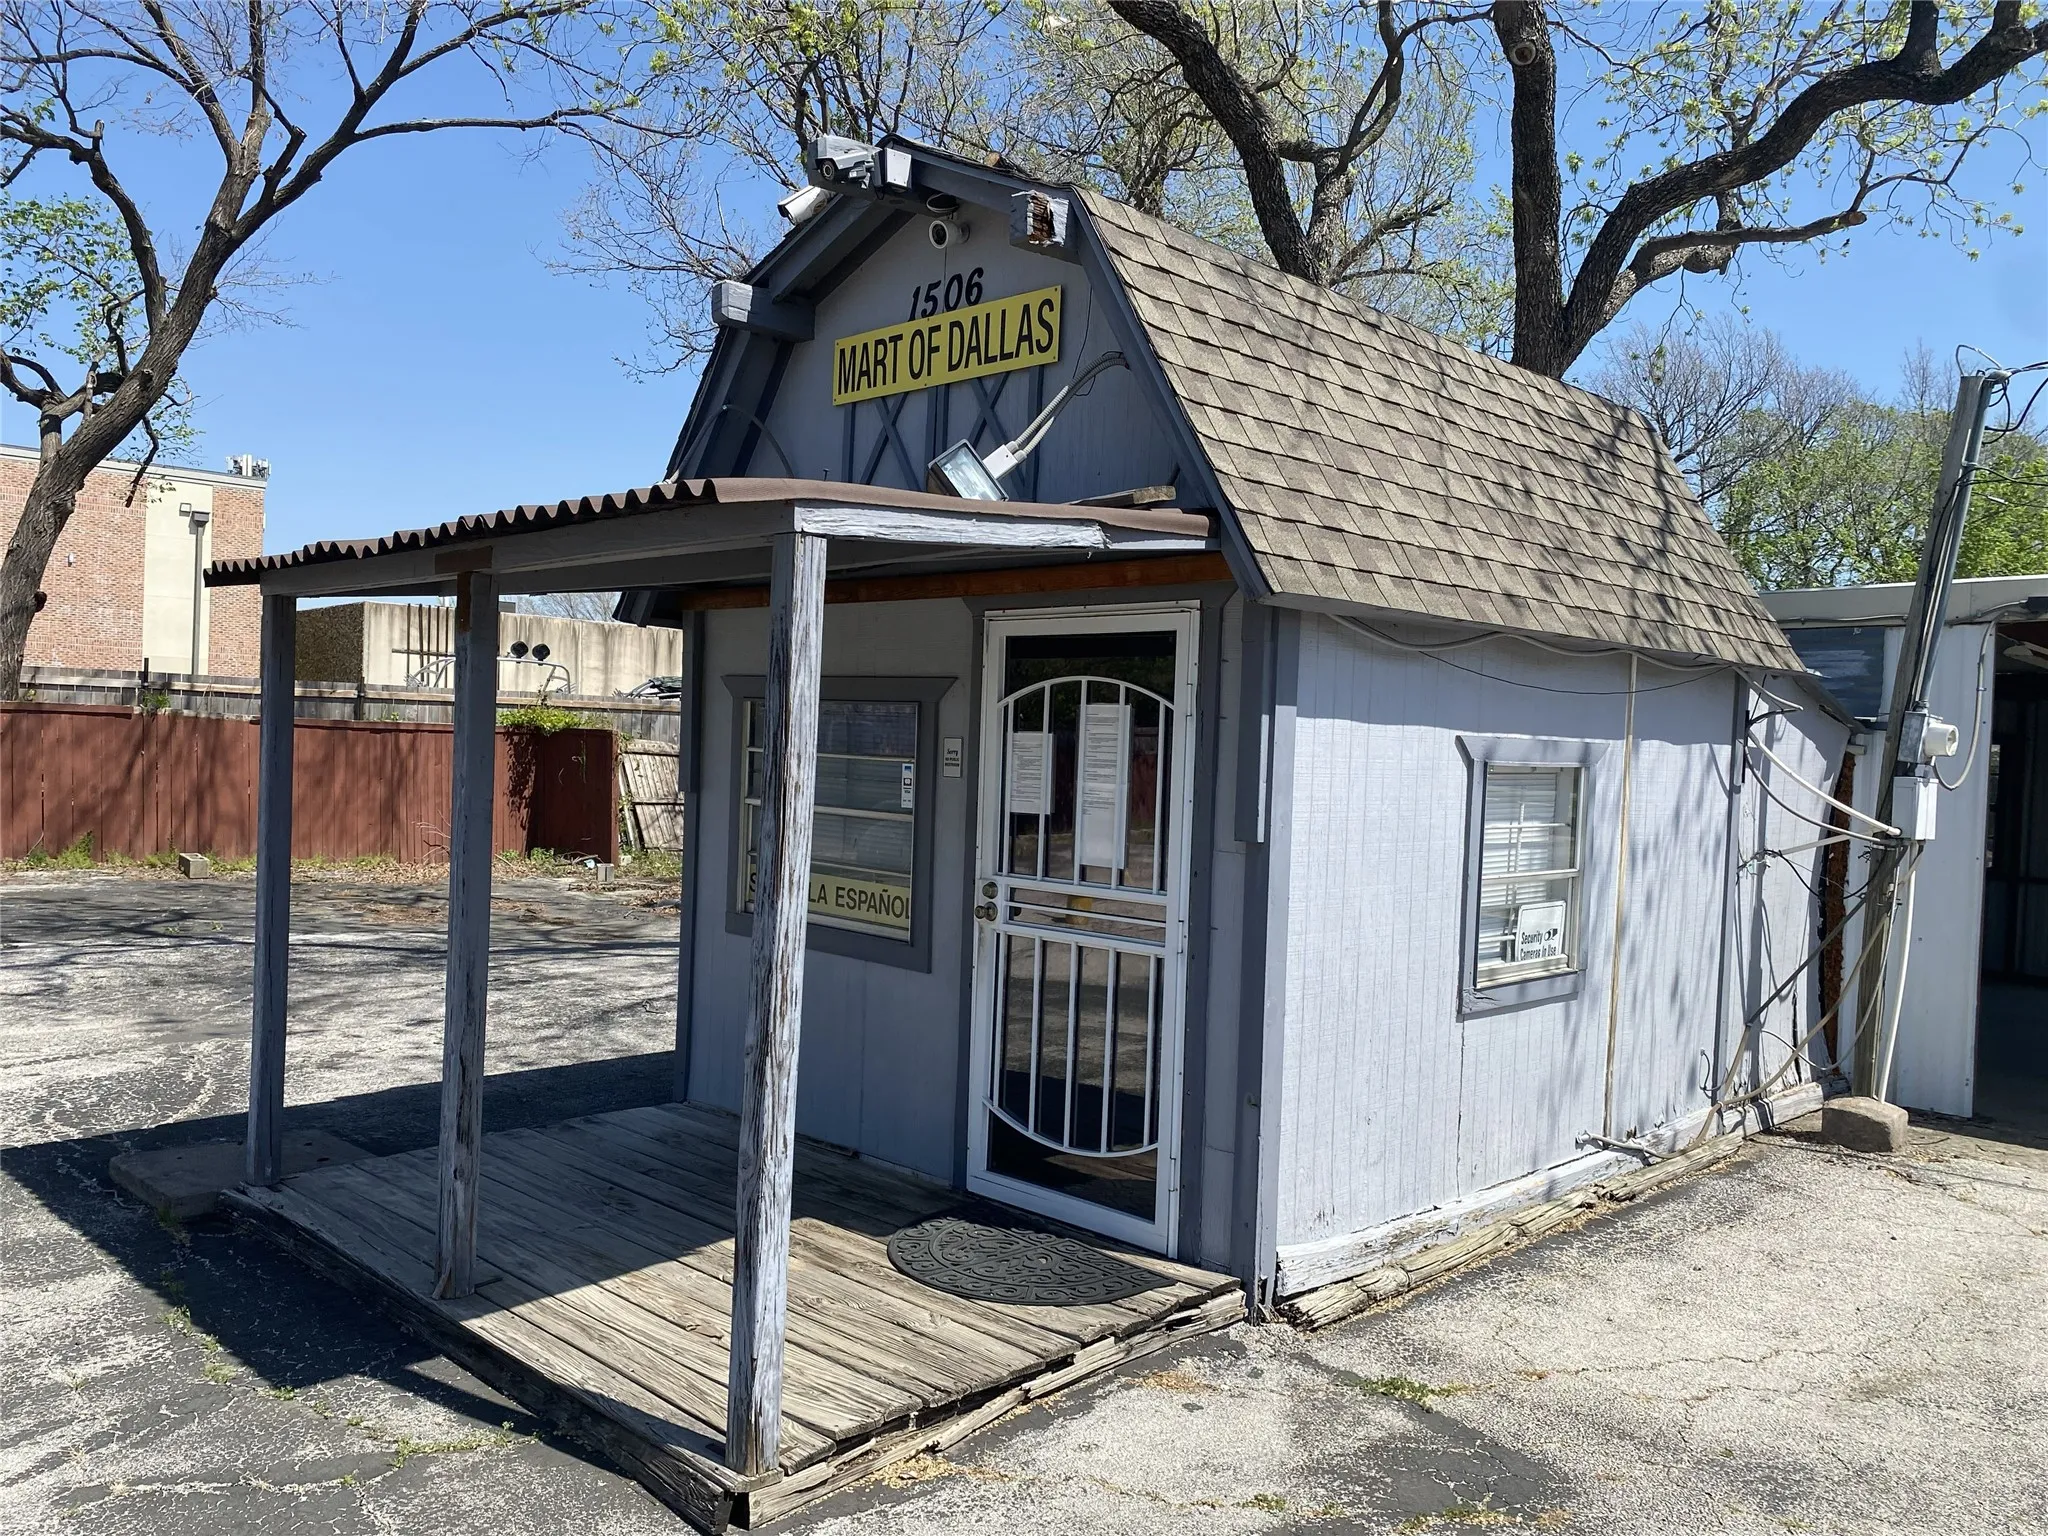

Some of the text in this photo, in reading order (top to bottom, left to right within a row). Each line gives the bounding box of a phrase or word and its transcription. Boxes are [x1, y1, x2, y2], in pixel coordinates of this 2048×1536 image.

[907, 266, 984, 323] 1506
[838, 298, 1054, 395] MART OF DALLAS
[1521, 930, 1543, 945] Security
